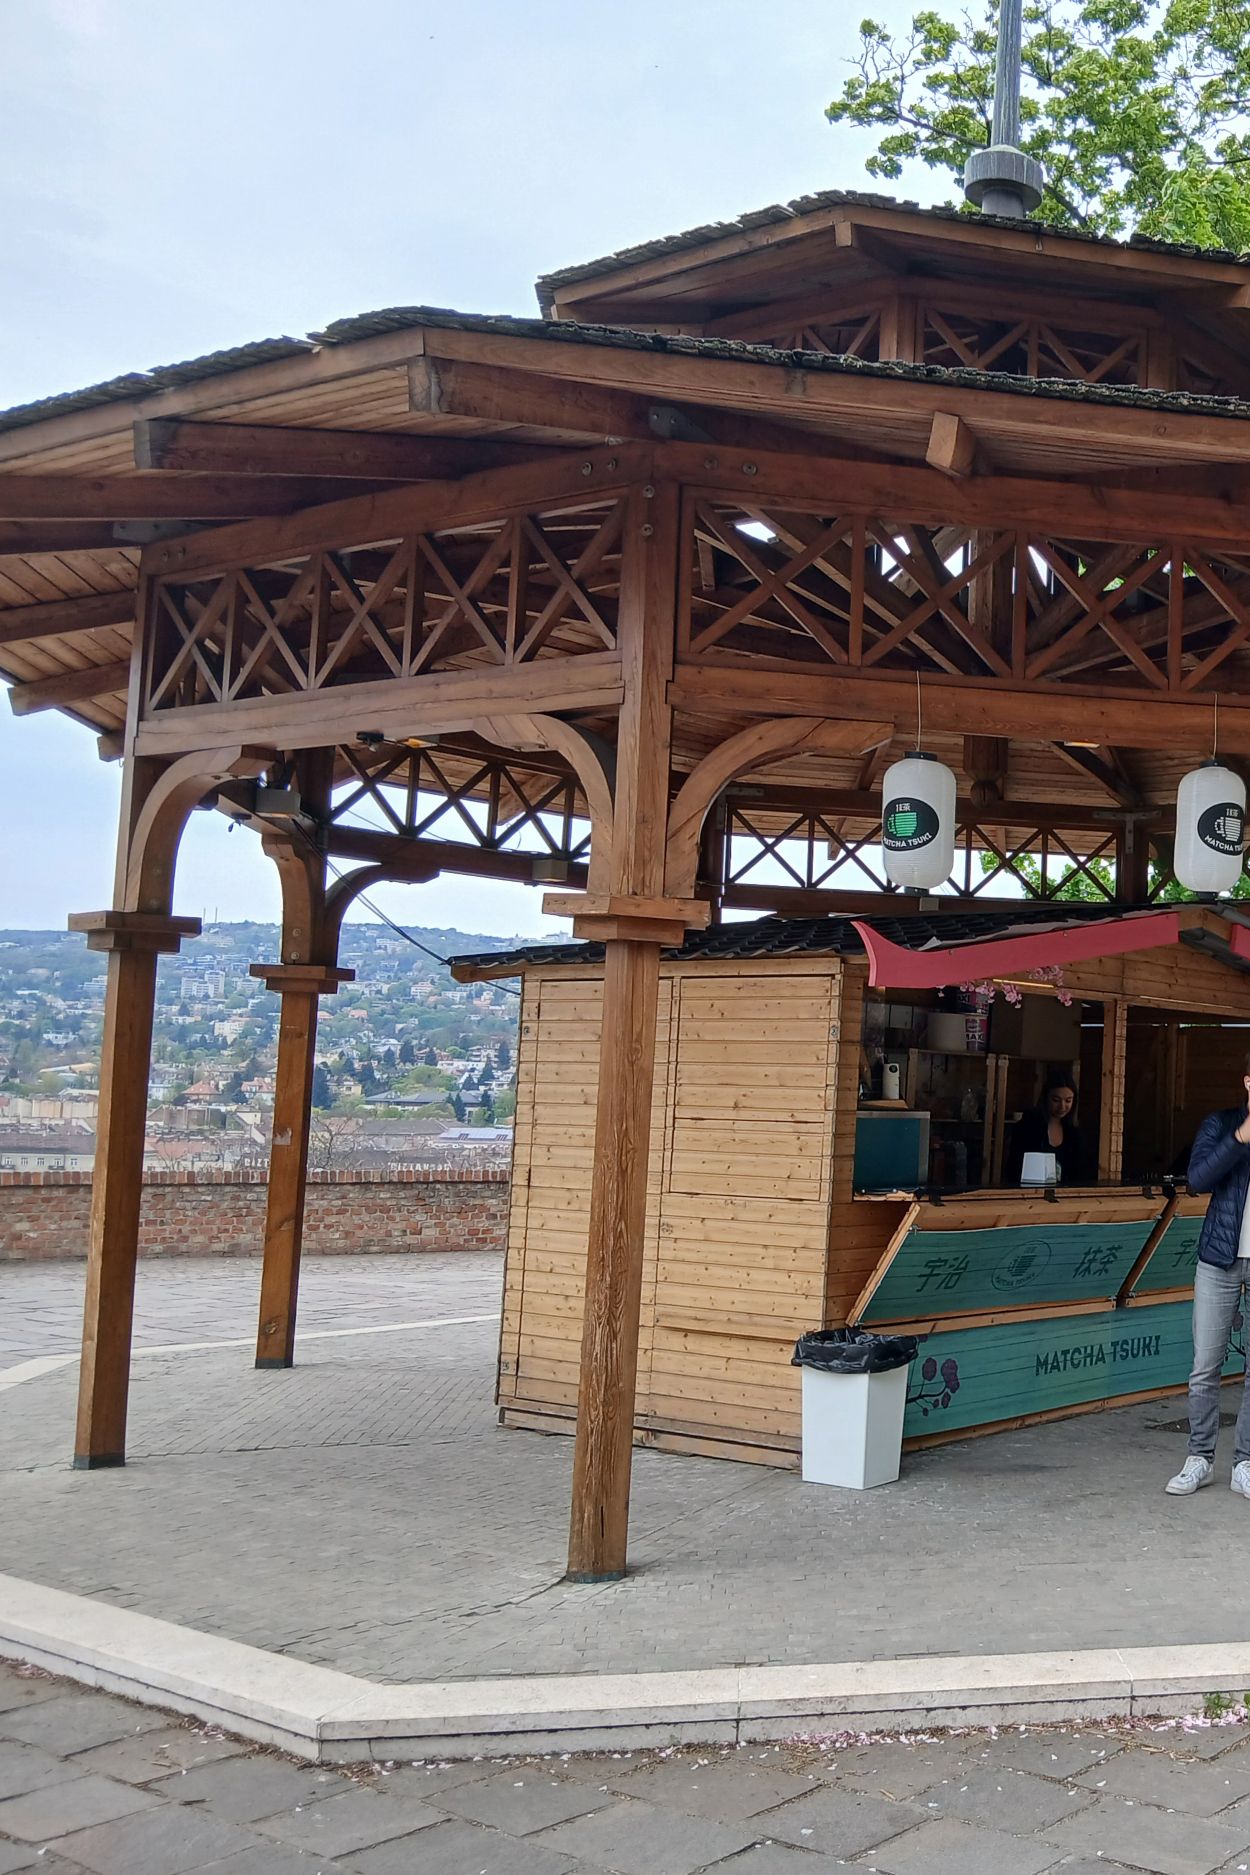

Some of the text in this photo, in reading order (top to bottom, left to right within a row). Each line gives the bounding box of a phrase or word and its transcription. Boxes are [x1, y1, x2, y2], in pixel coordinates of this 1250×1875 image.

[907, 832, 932, 846] TSUKI
[1204, 834, 1234, 852] MATCHA
[916, 1255, 970, 1292] 宇治
[1073, 1245, 1123, 1278] 抹茶
[1035, 1335, 1160, 1376] MATCHA TSUKI
